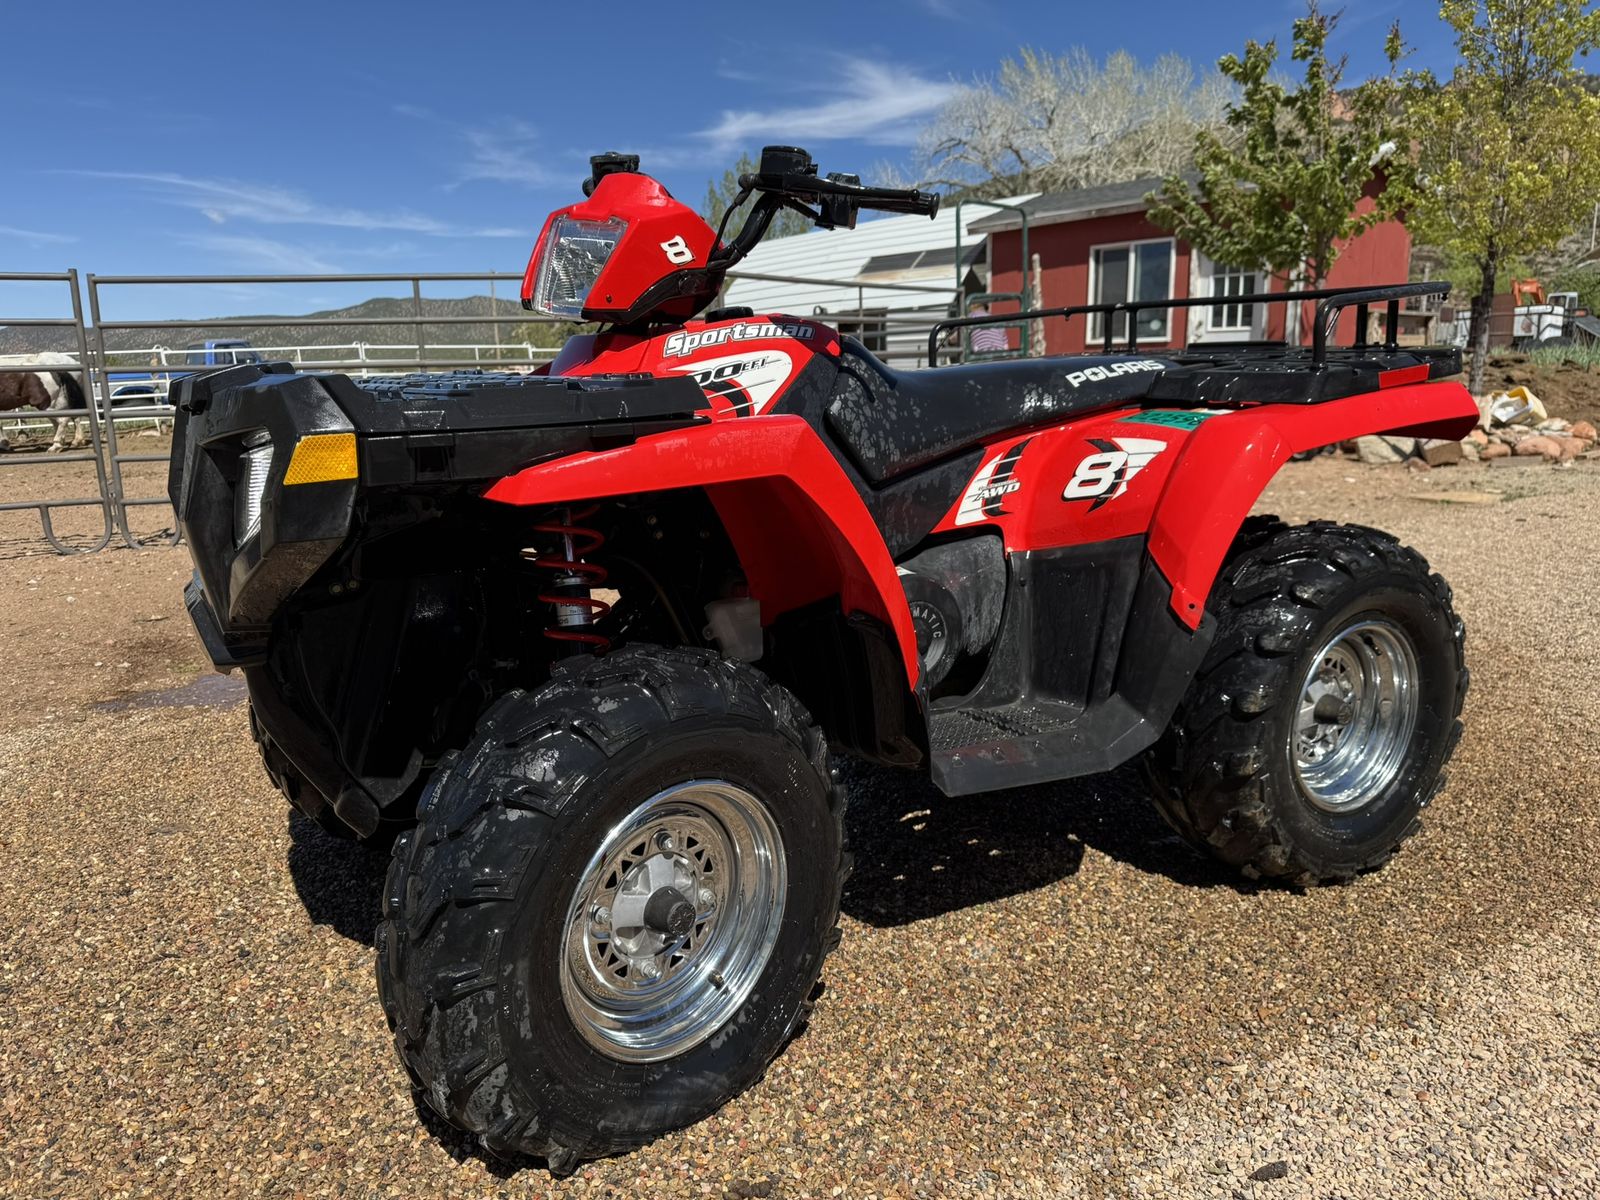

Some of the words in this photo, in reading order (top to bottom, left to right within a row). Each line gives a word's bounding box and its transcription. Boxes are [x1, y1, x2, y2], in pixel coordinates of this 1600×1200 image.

[660, 235, 695, 265] 8
[664, 323, 814, 357] Sportsman
[692, 361, 743, 386] 00
[1065, 360, 1166, 387] POLARIS
[1062, 450, 1129, 502] 8
[972, 482, 1020, 502] AWD
[912, 606, 942, 638] MATIC
